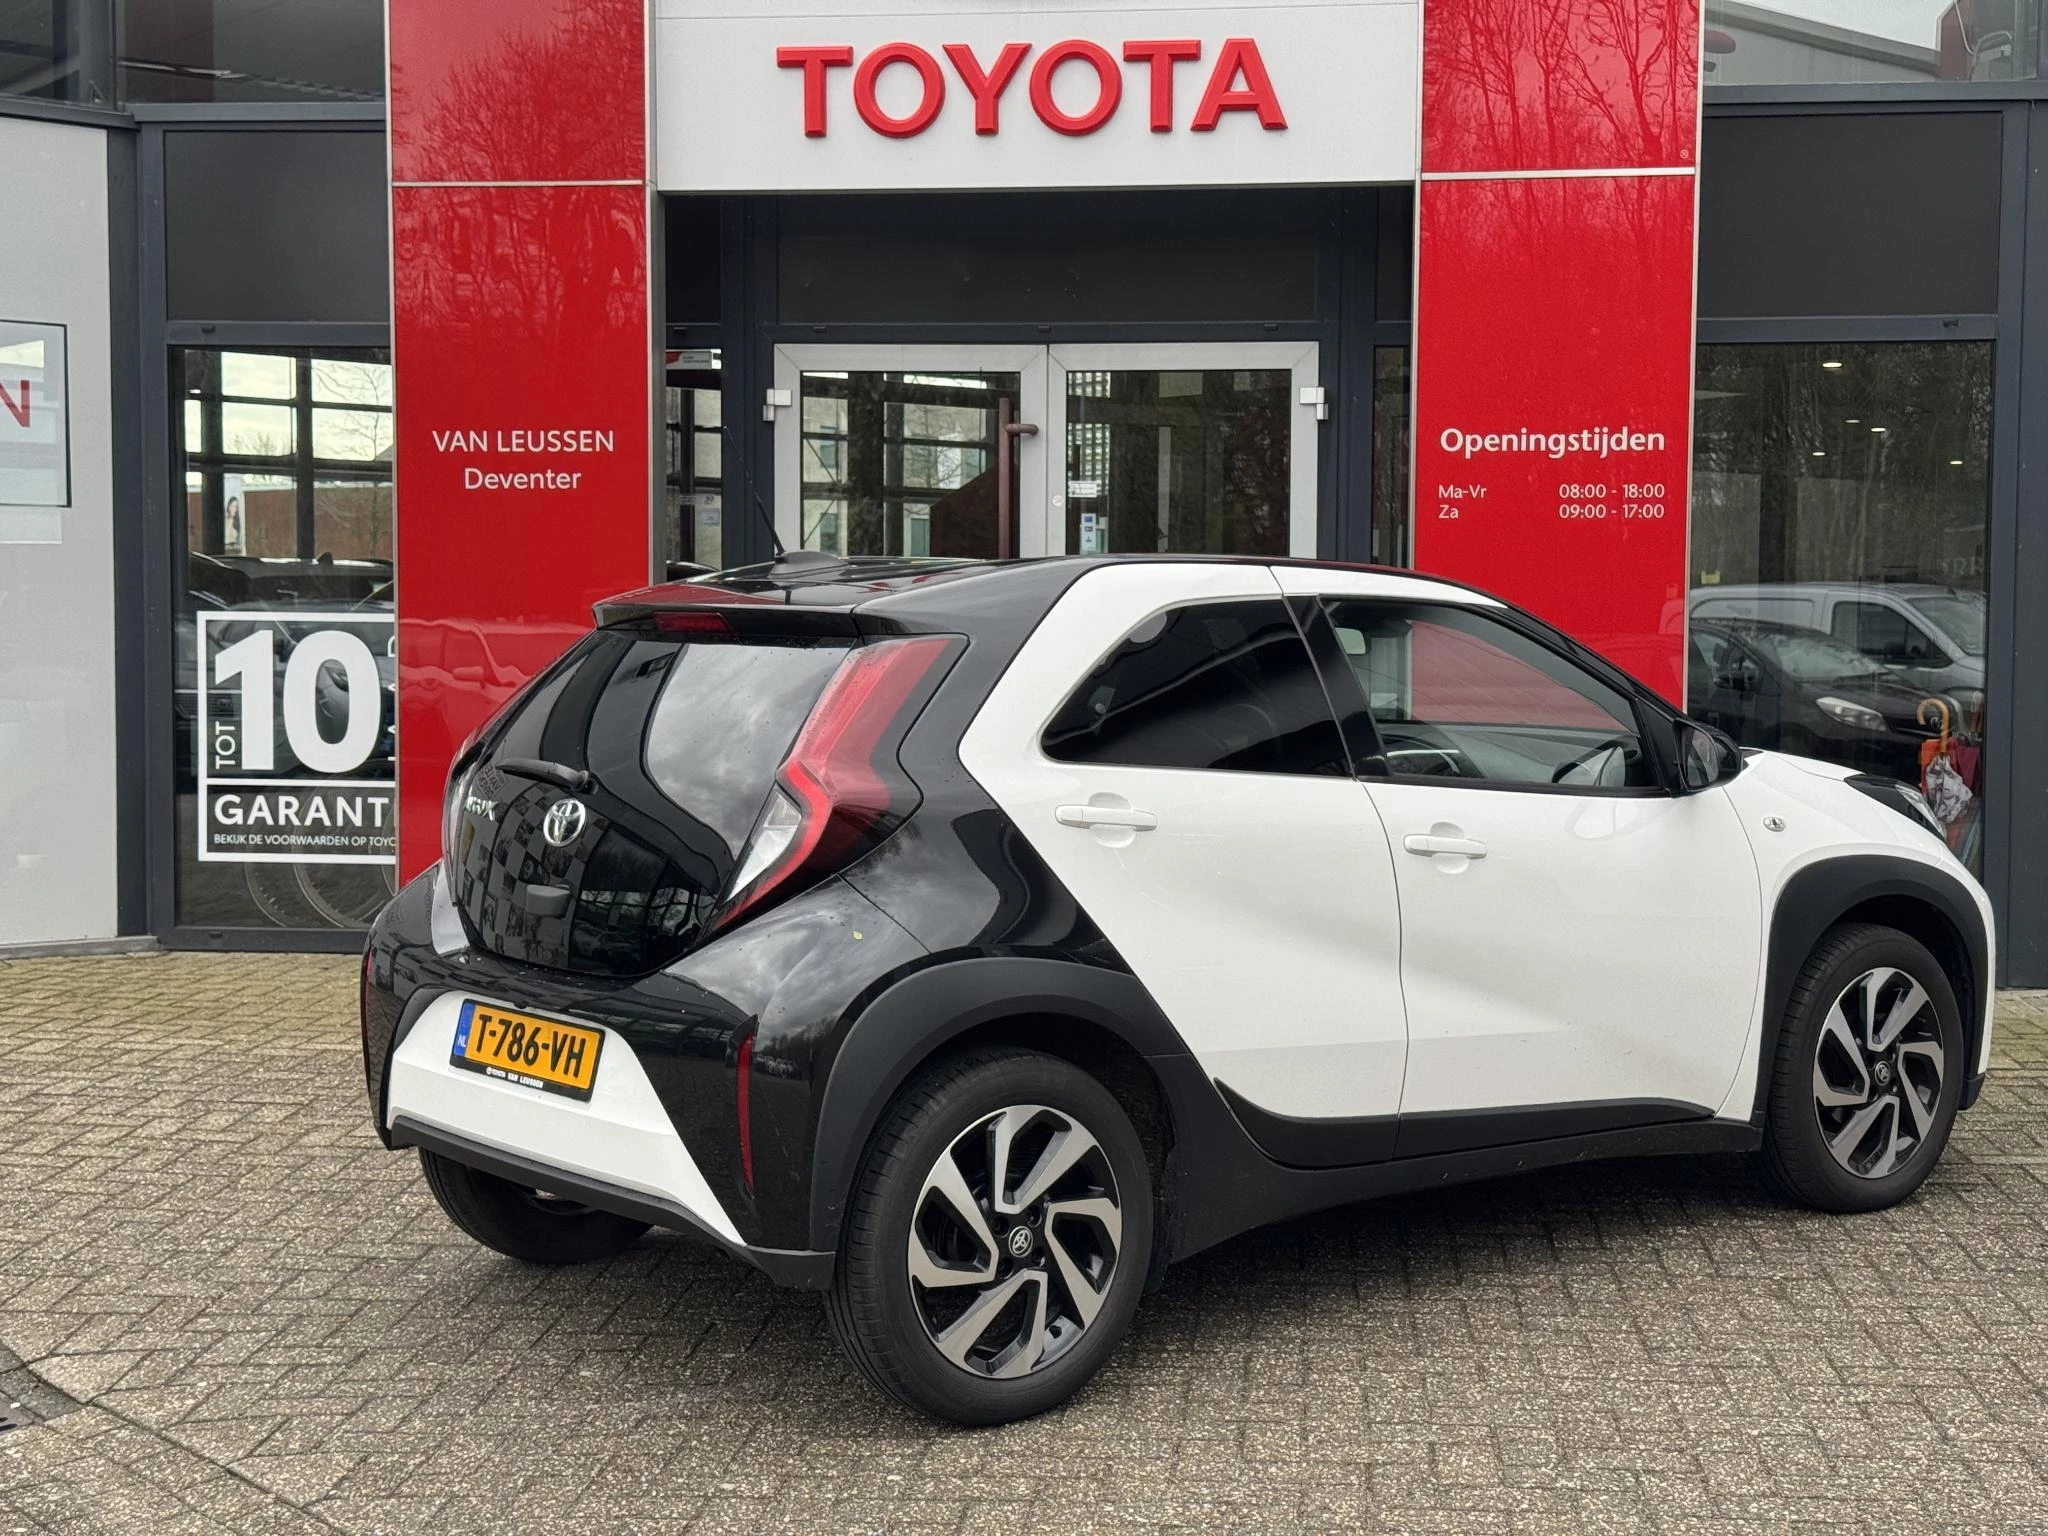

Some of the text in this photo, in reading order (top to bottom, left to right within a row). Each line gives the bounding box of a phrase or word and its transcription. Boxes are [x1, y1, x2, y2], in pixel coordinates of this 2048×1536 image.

[776, 38, 1288, 139] TOYOTA
[432, 430, 615, 452] VAN LEUSSEN
[1440, 426, 1665, 459] Openingstijden
[464, 467, 582, 490] Deventer
[1438, 484, 1487, 499] Ma-Vr
[1558, 483, 1607, 499] 08:00
[1622, 483, 1665, 499] 18:00
[1438, 504, 1459, 519] Za
[1558, 503, 1607, 519] 09:00
[1622, 503, 1665, 519] 17:00
[214, 629, 382, 774] 10
[215, 720, 236, 770] TOT
[214, 794, 396, 828] GARANT
[213, 833, 247, 845] BEKIJK
[249, 834, 263, 845] DE
[264, 834, 349, 847] VOORWAARDEN
[350, 836, 367, 847] OP
[457, 1034, 467, 1048] NL
[475, 1013, 586, 1078] T-786-VH
